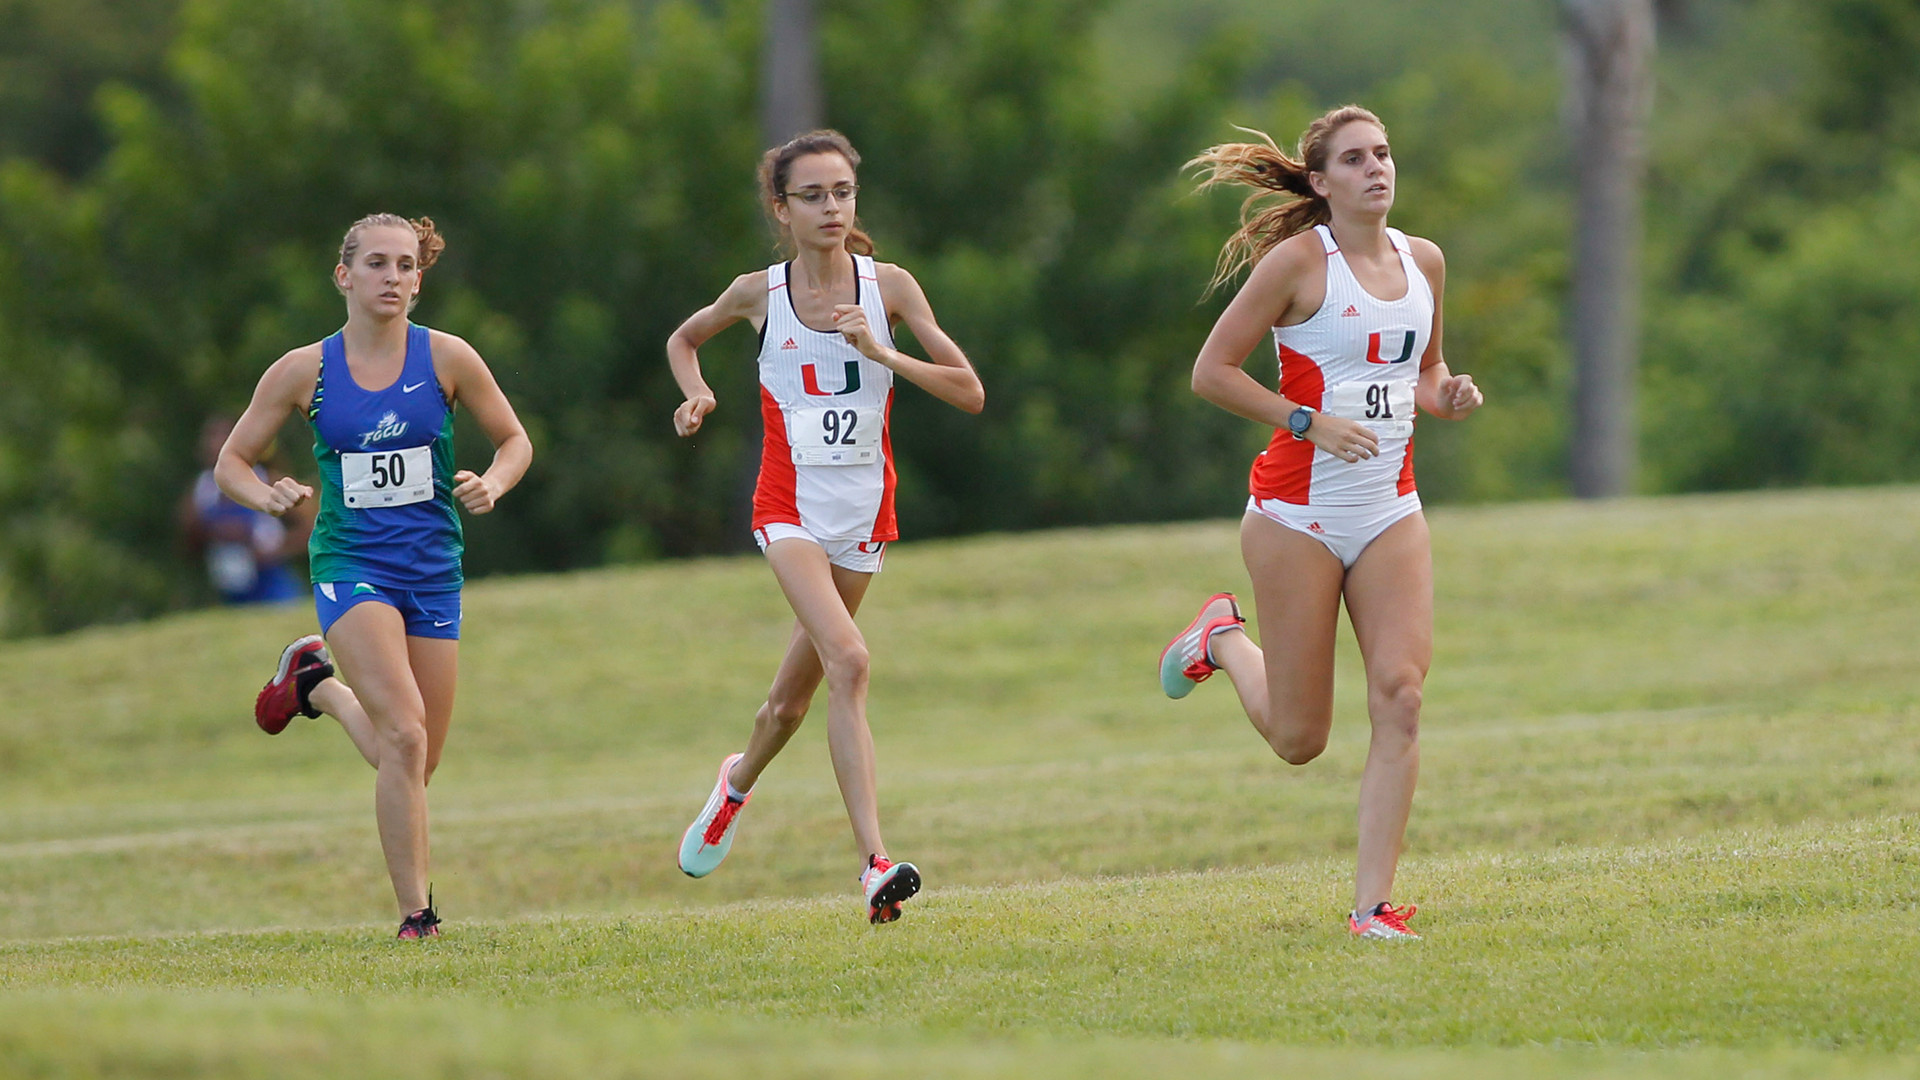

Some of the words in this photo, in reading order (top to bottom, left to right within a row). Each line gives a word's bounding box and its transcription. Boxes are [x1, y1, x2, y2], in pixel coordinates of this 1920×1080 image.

[1366, 330, 1416, 364] U
[800, 360, 861, 396] U
[1364, 383, 1394, 419] 91
[358, 421, 409, 449] FGCU
[822, 408, 858, 446] 92
[371, 452, 406, 489] 50
